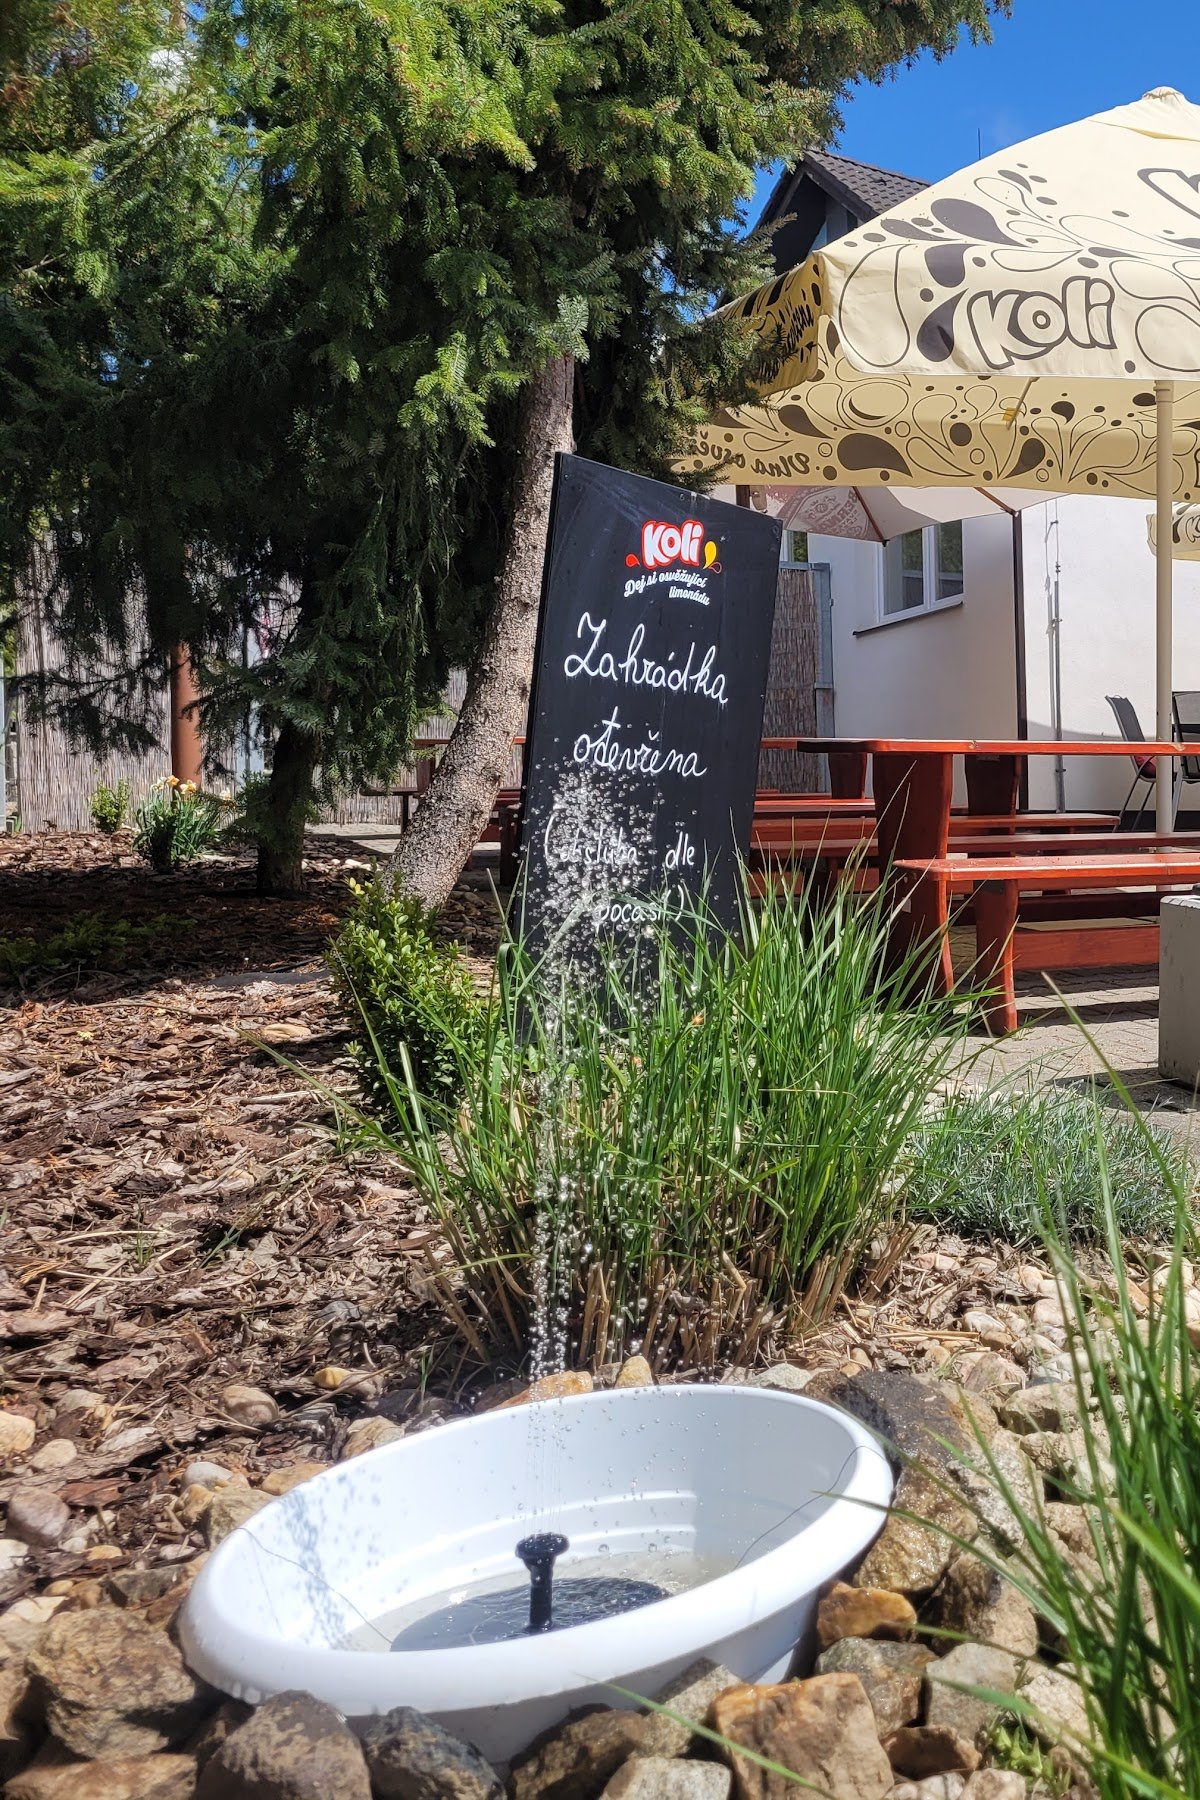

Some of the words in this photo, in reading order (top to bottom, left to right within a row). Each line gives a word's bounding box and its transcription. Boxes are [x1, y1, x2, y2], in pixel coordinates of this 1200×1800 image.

[967, 276, 1117, 370] Koli
[624, 579, 646, 597] Dej
[646, 571, 658, 586] si
[659, 569, 708, 588] osvěžující
[669, 586, 710, 606] limonádu
[564, 612, 728, 703] Zahrádka
[573, 706, 707, 777] otevřena
[665, 831, 695, 868] dle
